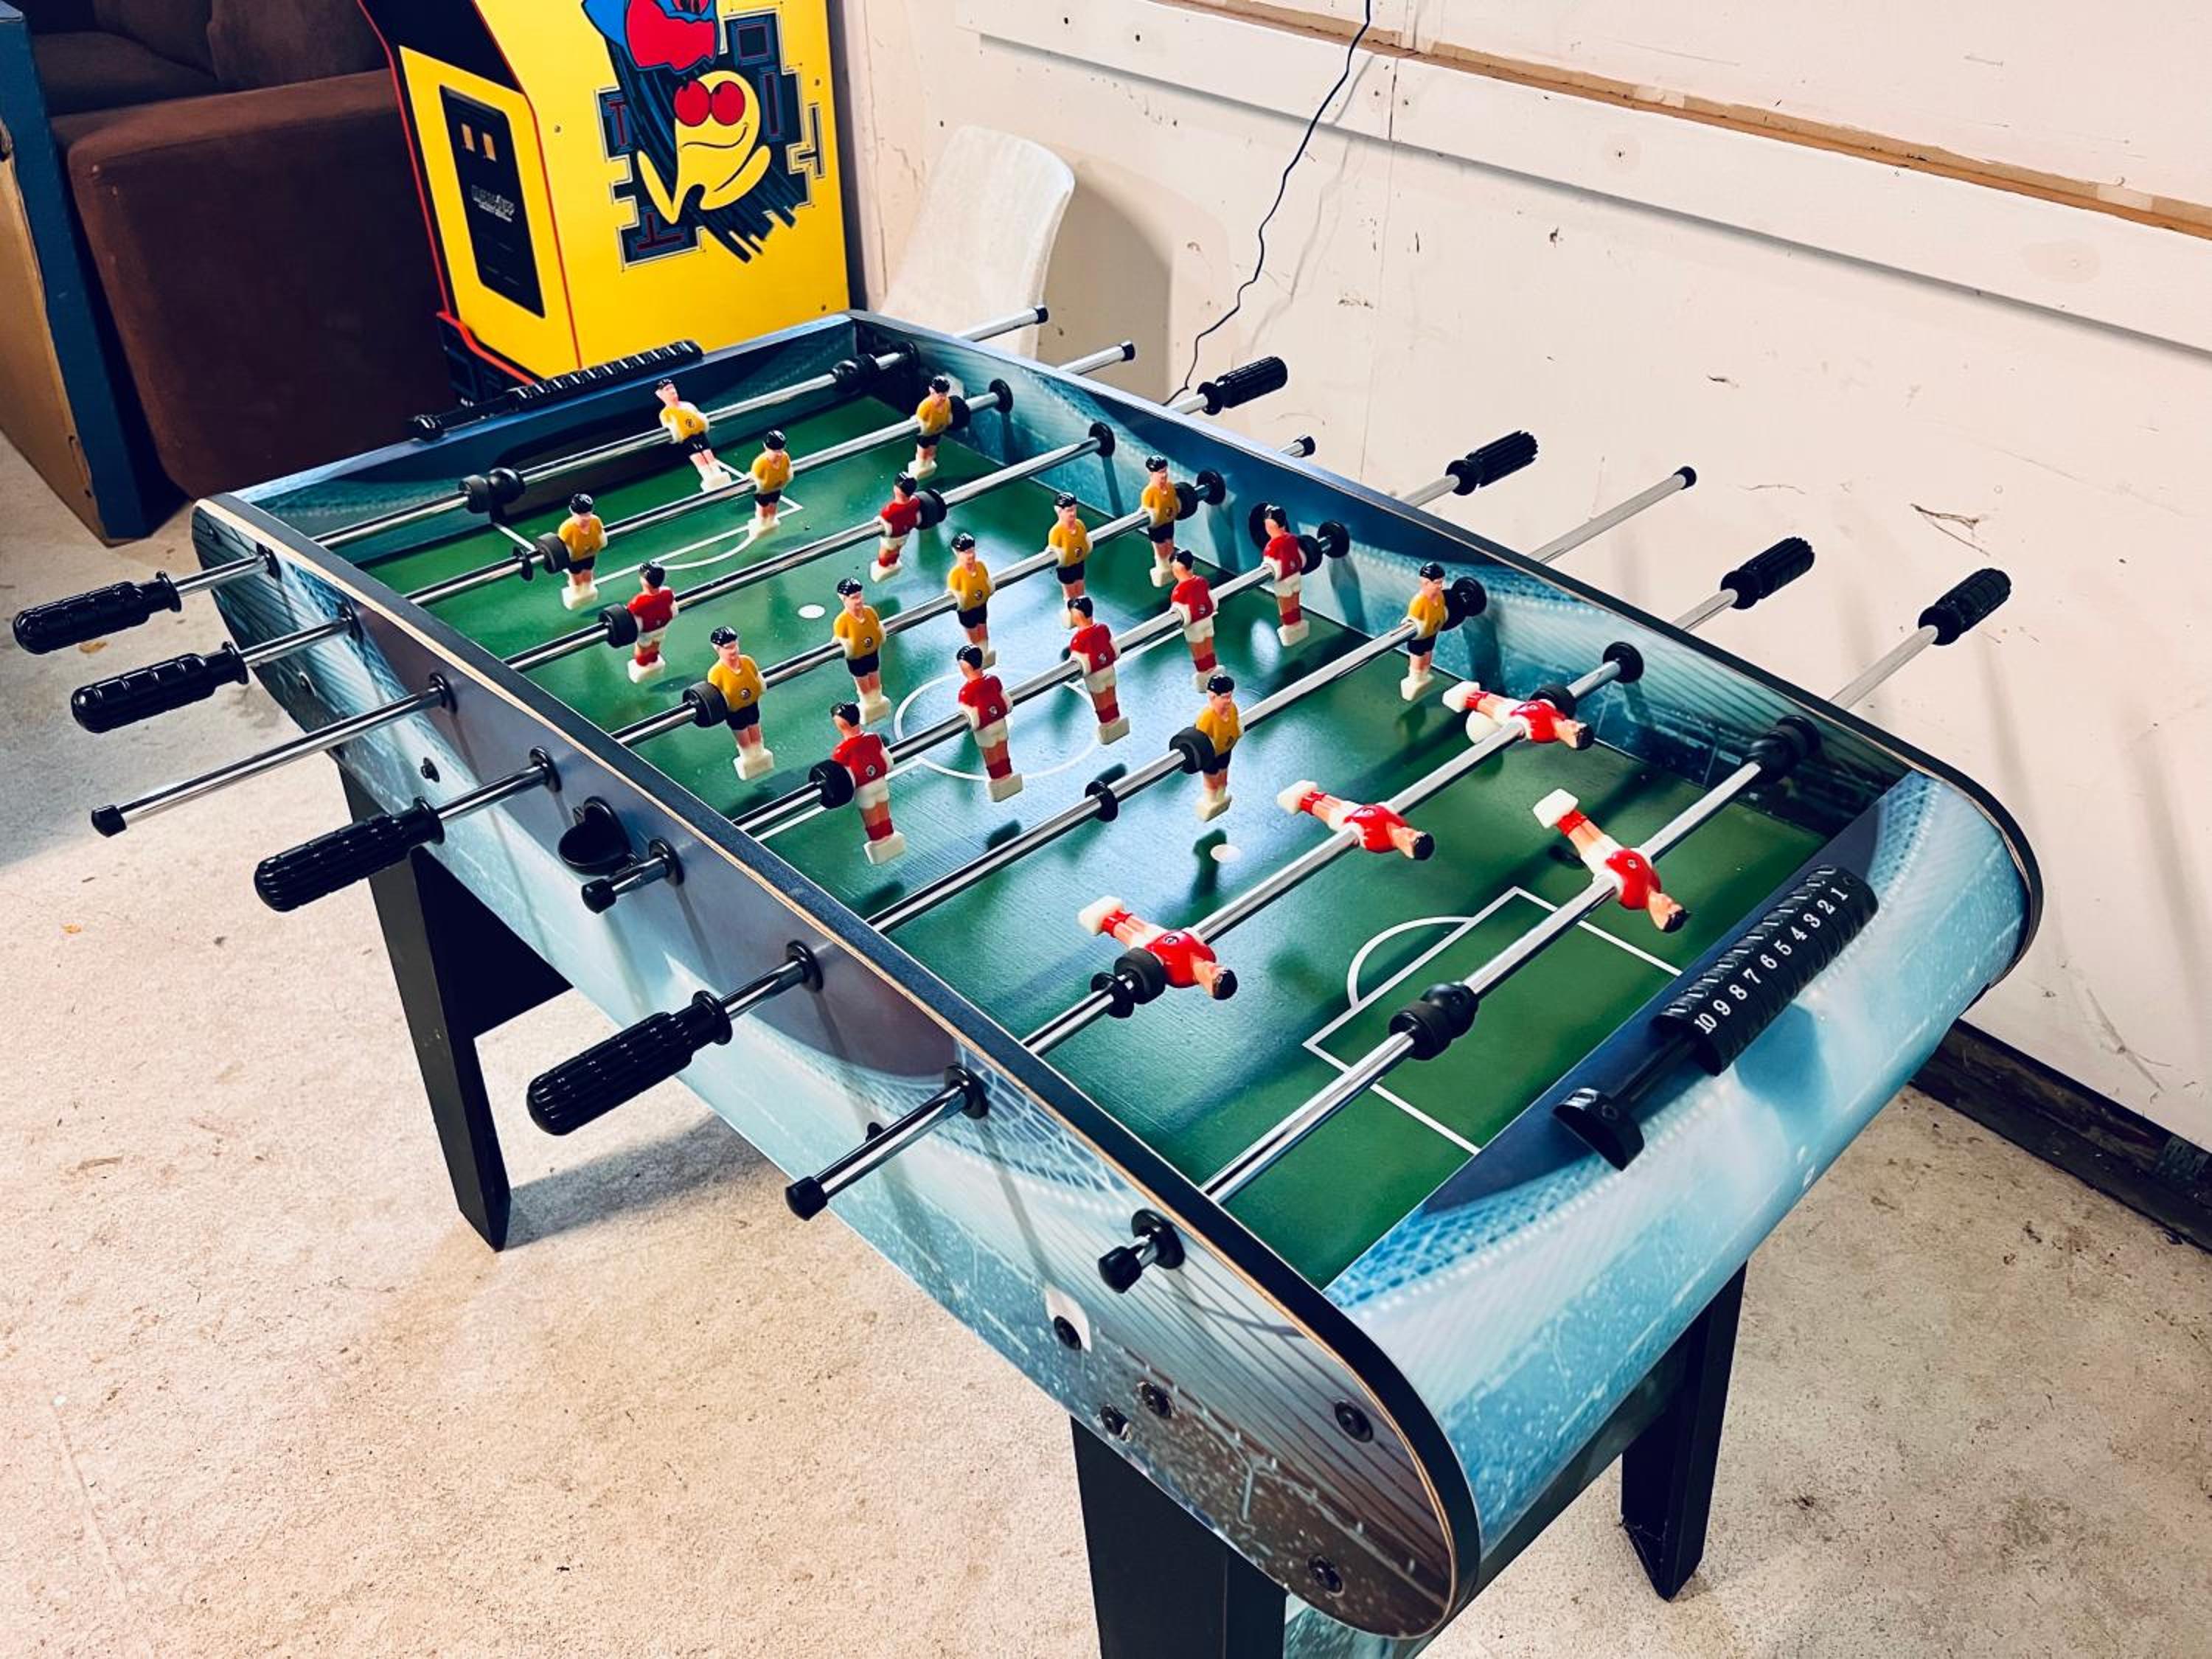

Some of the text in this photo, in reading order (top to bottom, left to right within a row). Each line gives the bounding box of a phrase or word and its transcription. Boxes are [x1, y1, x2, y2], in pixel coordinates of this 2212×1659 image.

[1694, 887, 1848, 1034] 10 9 8 7 6 5 4 3 2 1
